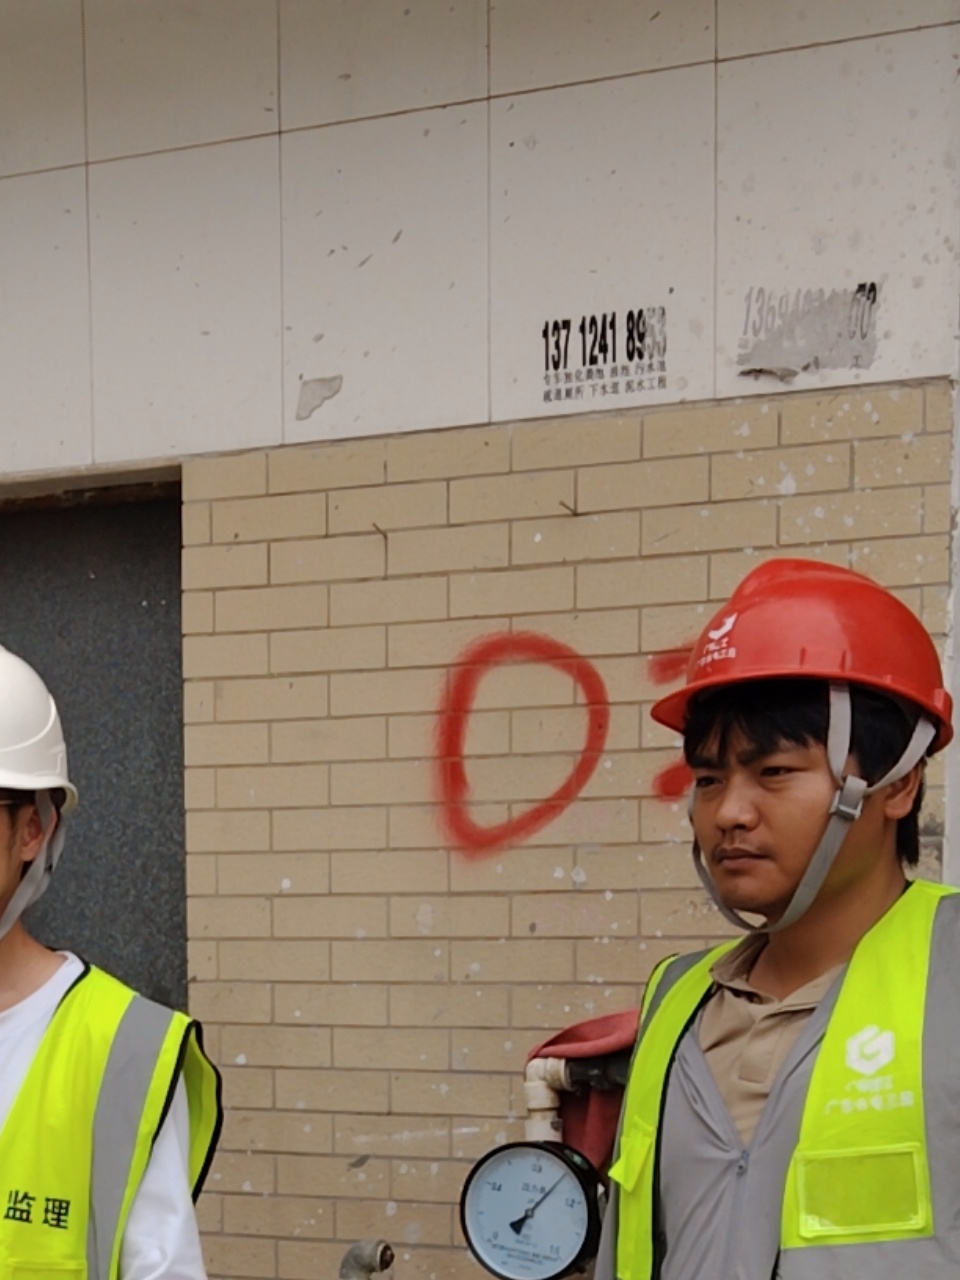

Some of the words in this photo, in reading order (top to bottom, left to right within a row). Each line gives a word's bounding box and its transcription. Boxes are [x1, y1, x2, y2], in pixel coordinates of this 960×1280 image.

[542, 319, 571, 372] 137
[579, 311, 617, 367] 1241
[3, 1190, 70, 1230] 监理
